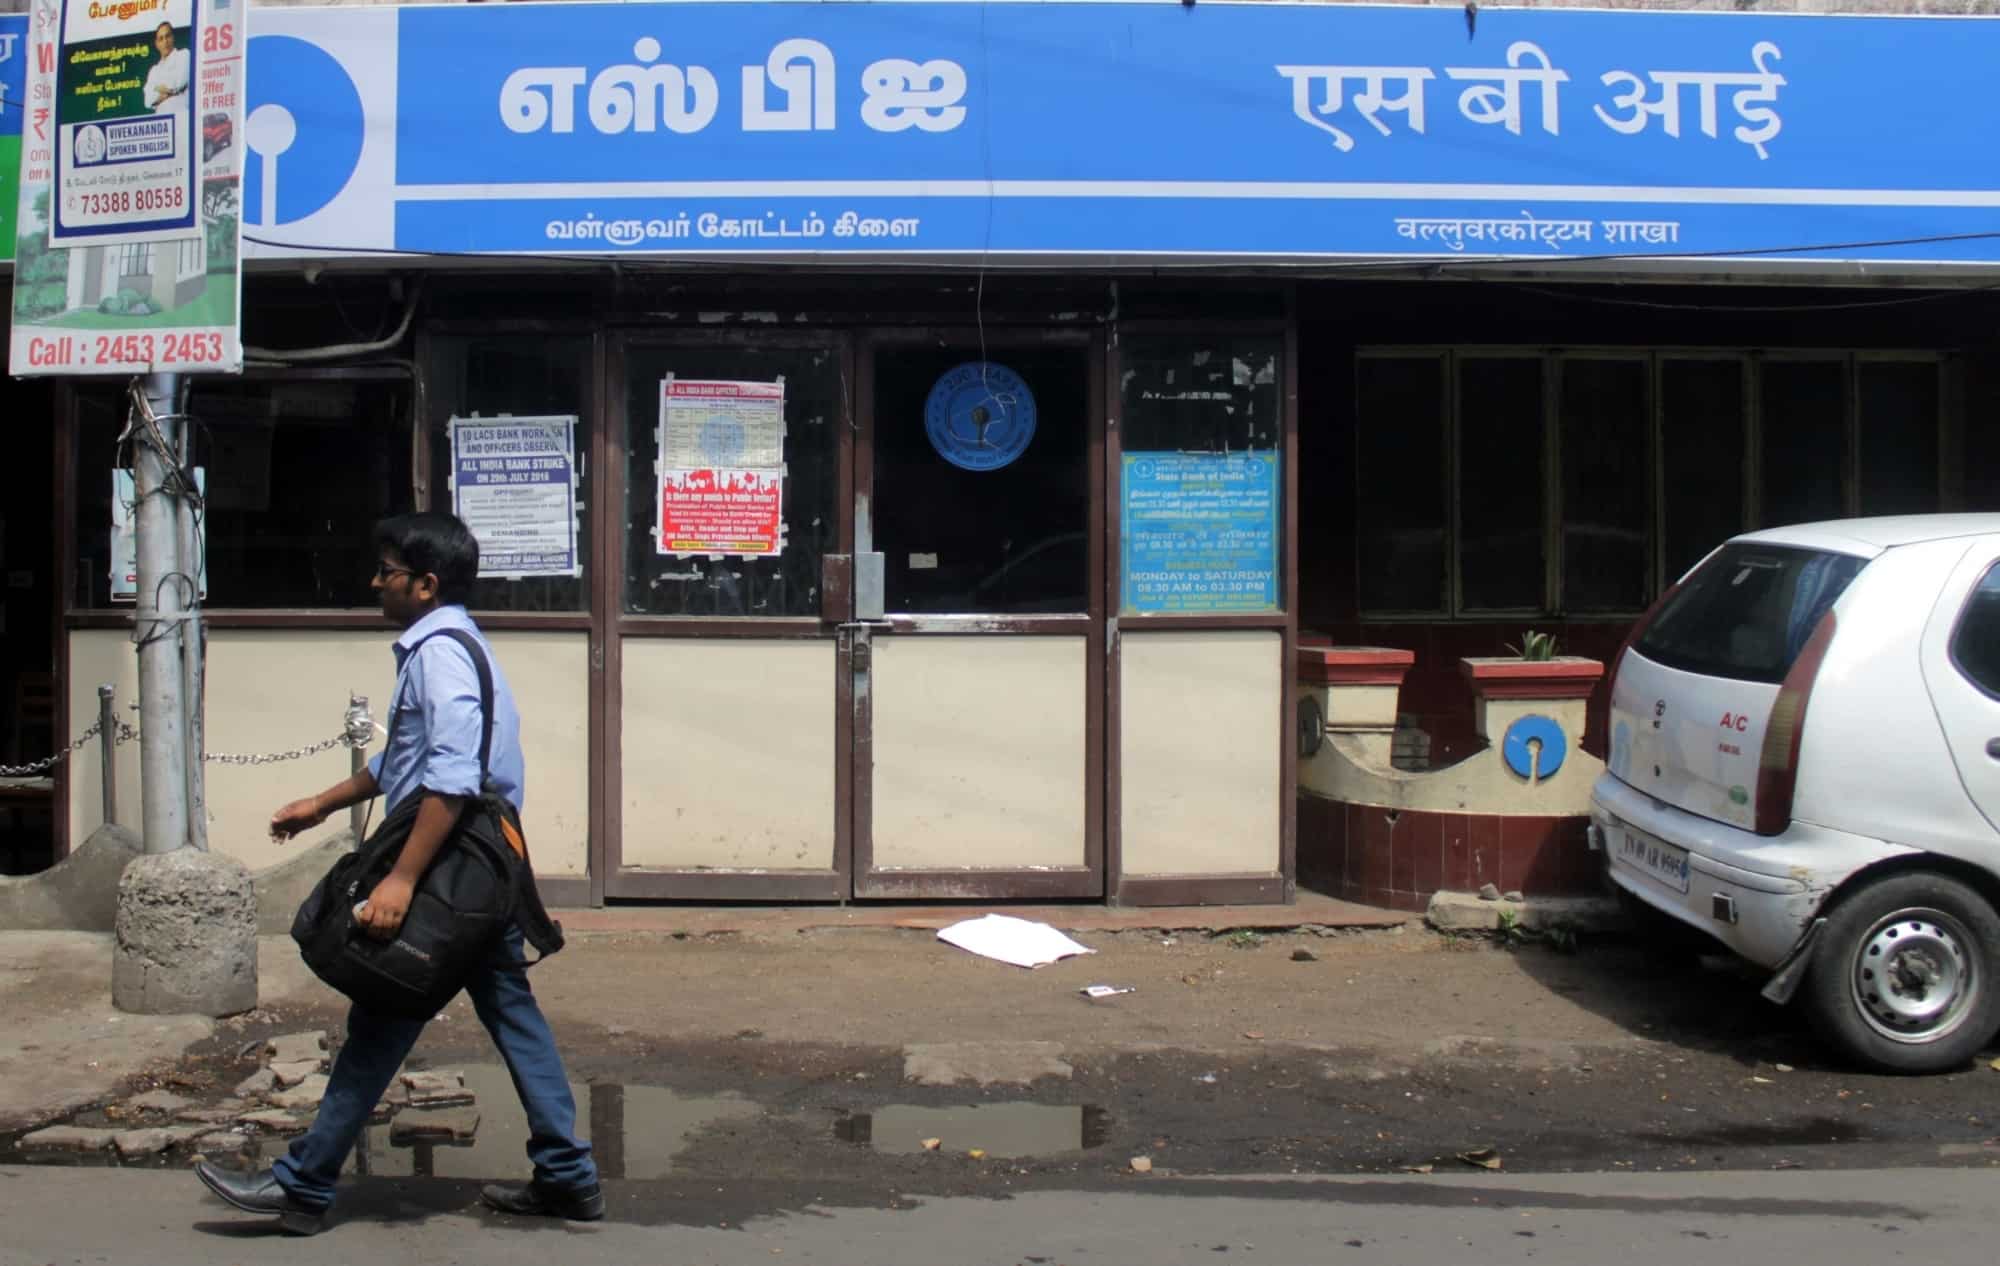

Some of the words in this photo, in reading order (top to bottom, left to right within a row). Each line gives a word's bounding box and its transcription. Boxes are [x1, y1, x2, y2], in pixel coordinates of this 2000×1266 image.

[500, 37, 718, 134] எஸ்
[742, 39, 835, 131] பி
[861, 59, 967, 132] ஐ
[212, 94, 236, 108] FREE
[1276, 65, 1435, 152] एस
[1445, 41, 1570, 136] बी
[1593, 41, 1787, 160] आई
[109, 122, 169, 139] VIVEKANANDA
[109, 143, 137, 156] SPOKEN
[139, 140, 170, 154] ENGLISH
[175, 168, 183, 177] 17
[81, 192, 130, 215] 73388
[136, 186, 183, 210] 80558
[546, 213, 691, 246] வள்ளுவர்
[697, 211, 825, 238] கோட்டம்
[832, 211, 920, 237] கிளை
[1395, 211, 1592, 250] वल्लुवरकोट्टम
[1602, 220, 1680, 243] शाखा
[29, 337, 72, 366] Call
[95, 336, 153, 365] 2453
[163, 333, 223, 363] 2453
[474, 430, 494, 440] LACS
[497, 429, 520, 440] BANK
[466, 443, 482, 453] AND
[484, 441, 521, 453] OFFICERS
[462, 461, 478, 471] ALL
[480, 460, 503, 471] INDIA
[505, 459, 530, 470] BANK
[532, 458, 565, 470] STRIKE
[510, 472, 529, 483] JULY
[1131, 571, 1185, 582] MONDAY
[1188, 572, 1200, 581] to
[1204, 570, 1273, 581] SATURDAY
[1172, 583, 1193, 593] AM
[1196, 583, 1208, 592] to
[1246, 582, 1265, 591] PM
[1720, 711, 1748, 732] A/C
